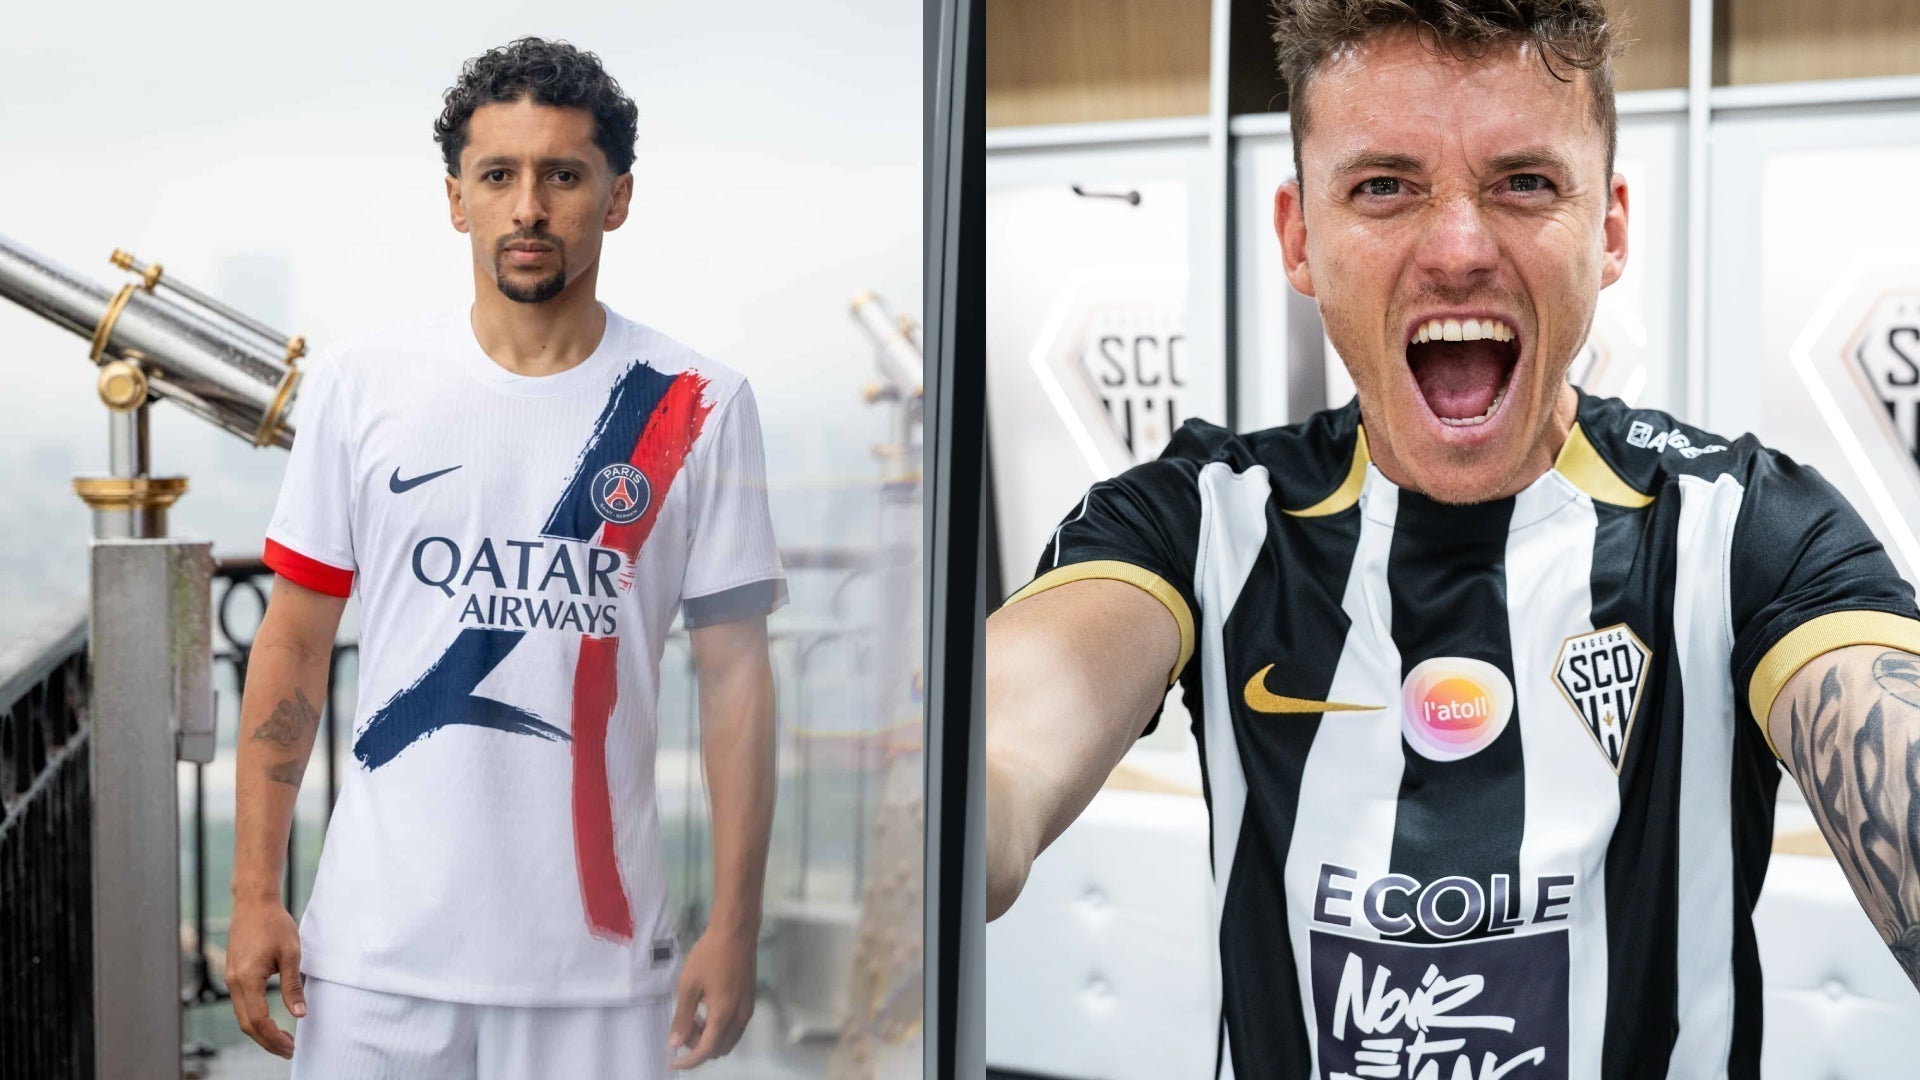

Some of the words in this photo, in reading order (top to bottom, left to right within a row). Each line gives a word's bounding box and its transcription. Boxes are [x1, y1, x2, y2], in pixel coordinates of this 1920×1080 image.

[603, 467, 642, 484] PARIS
[411, 536, 621, 599] QATAR
[458, 593, 617, 635] AIRWAYS
[1569, 644, 1633, 693] SCO
[1424, 696, 1488, 722] l'atoll
[1312, 863, 1575, 939] ECOLE
